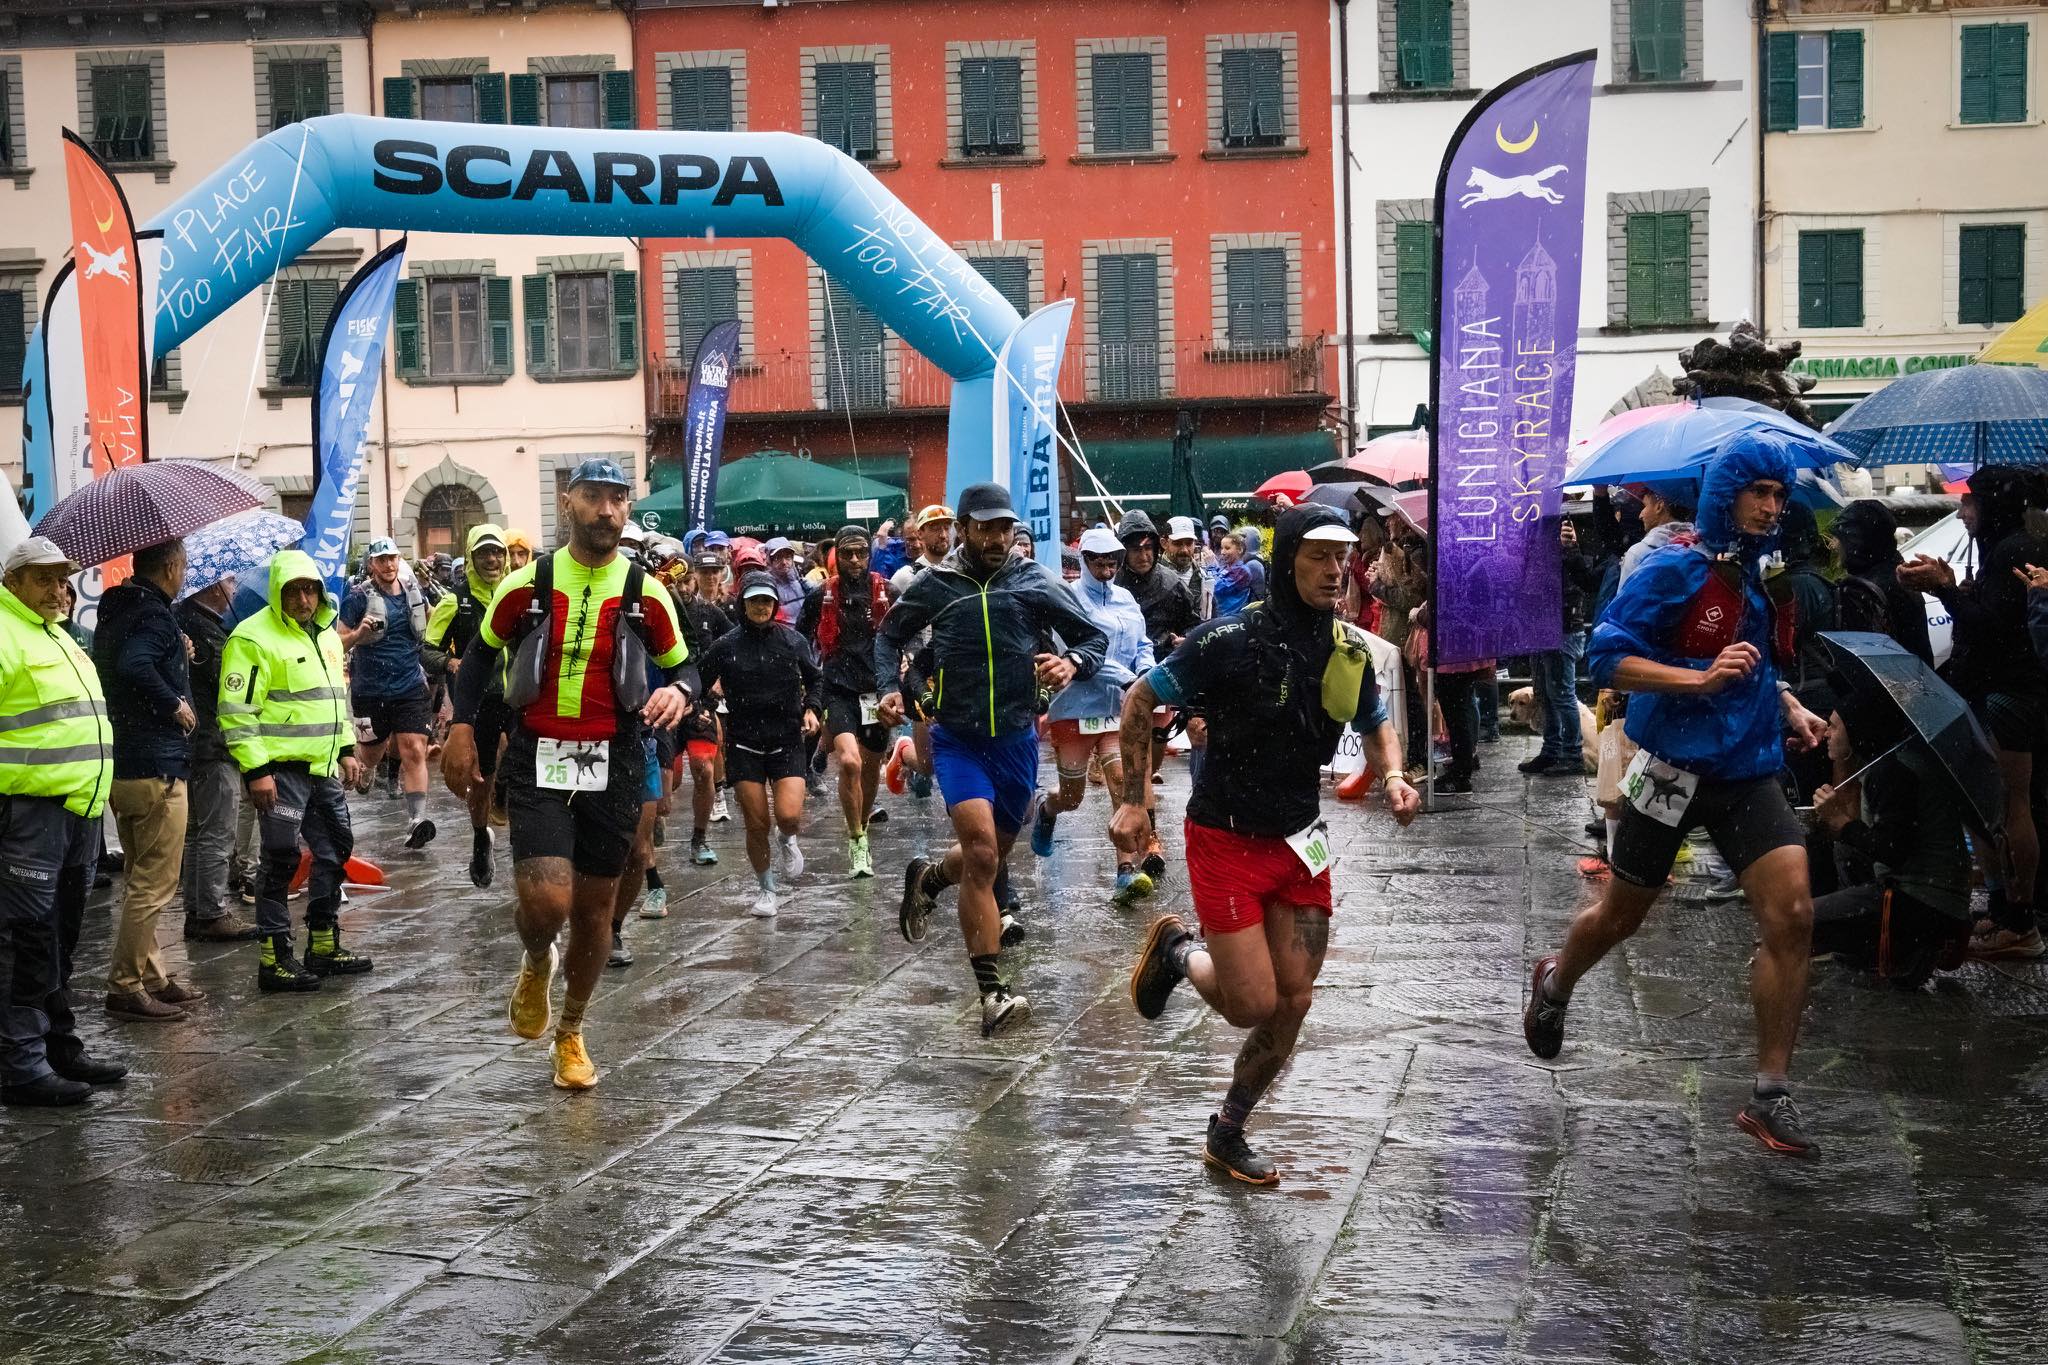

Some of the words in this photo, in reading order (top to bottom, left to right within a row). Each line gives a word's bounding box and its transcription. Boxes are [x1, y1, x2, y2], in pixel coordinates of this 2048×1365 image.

[373, 139, 785, 207] SCARPA
[172, 160, 267, 253] PLACE
[842, 223, 898, 275] TOO
[873, 201, 916, 238] NO
[918, 237, 994, 305] PLACE
[155, 277, 211, 332] TOO
[1033, 332, 1059, 431] TRAIL
[1791, 356, 1900, 379] ARMACIA
[69, 425, 79, 458] Toscana
[705, 400, 719, 450] NATURA
[1456, 315, 1502, 542] LUNIGIANA
[1511, 338, 1555, 523] SKYRACE
[703, 450, 713, 470] LA
[1031, 433, 1052, 543] ELBA
[1084, 717, 1100, 730] 49
[544, 764, 568, 784] 25
[1305, 839, 1327, 867] 90
